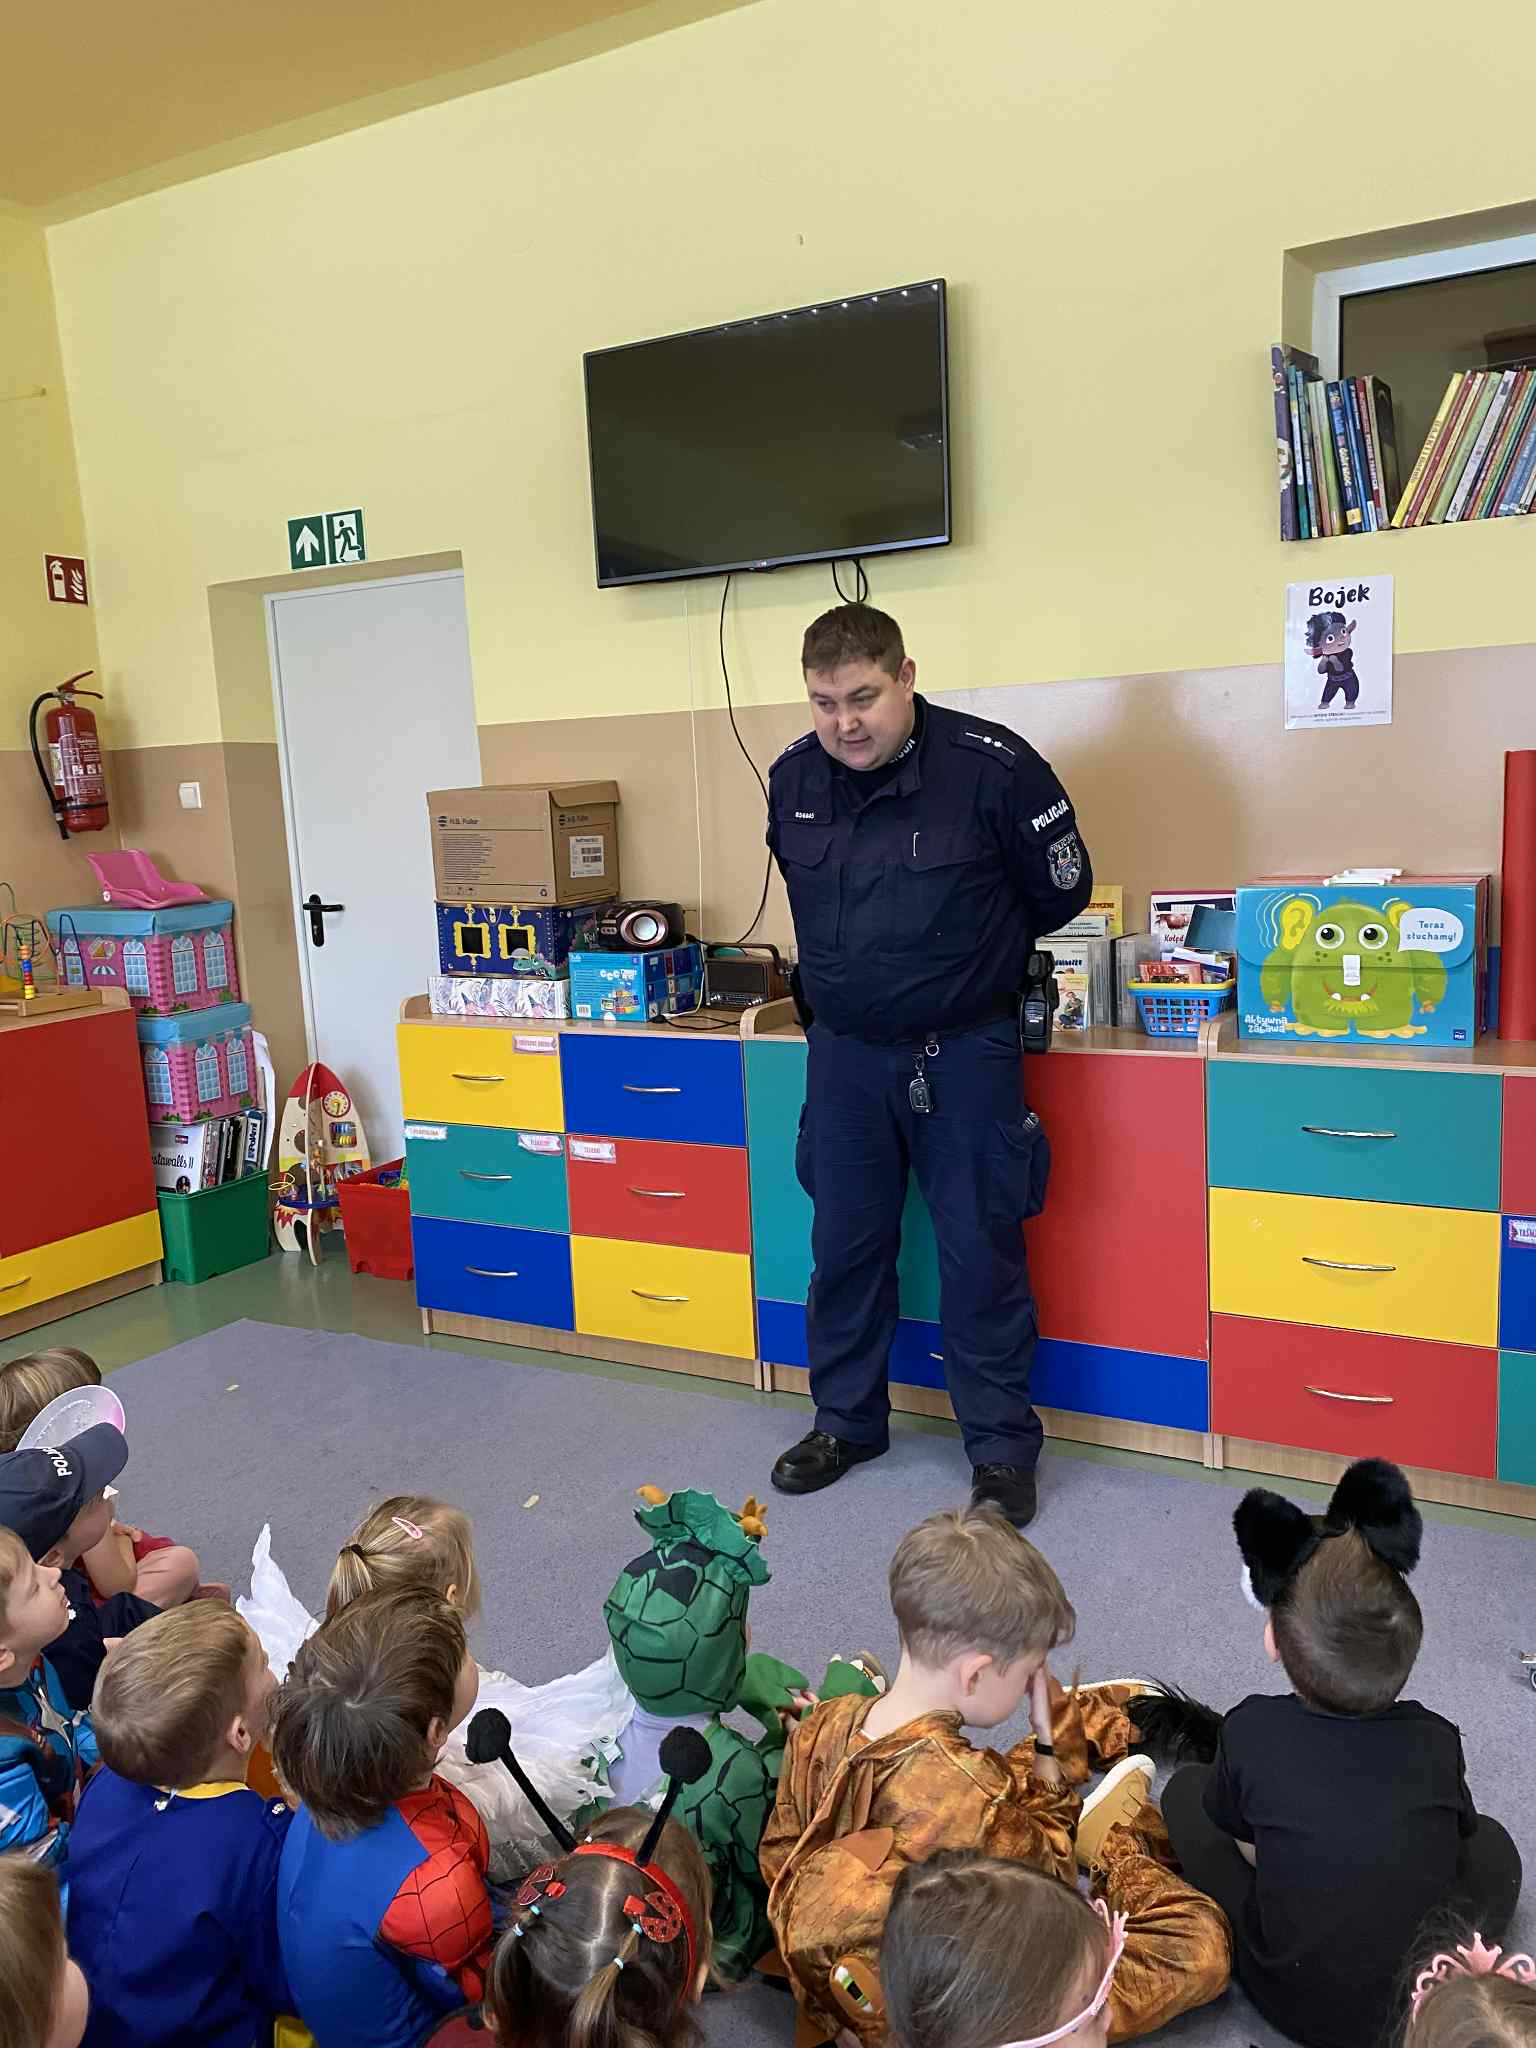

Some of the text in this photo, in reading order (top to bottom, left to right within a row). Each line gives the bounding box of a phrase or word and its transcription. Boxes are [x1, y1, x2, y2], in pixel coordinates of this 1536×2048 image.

[1308, 584, 1370, 608] Bojek
[1031, 799, 1070, 832] POLICJA
[1418, 920, 1445, 929] Teraz
[1244, 1014, 1288, 1026] Aktywna
